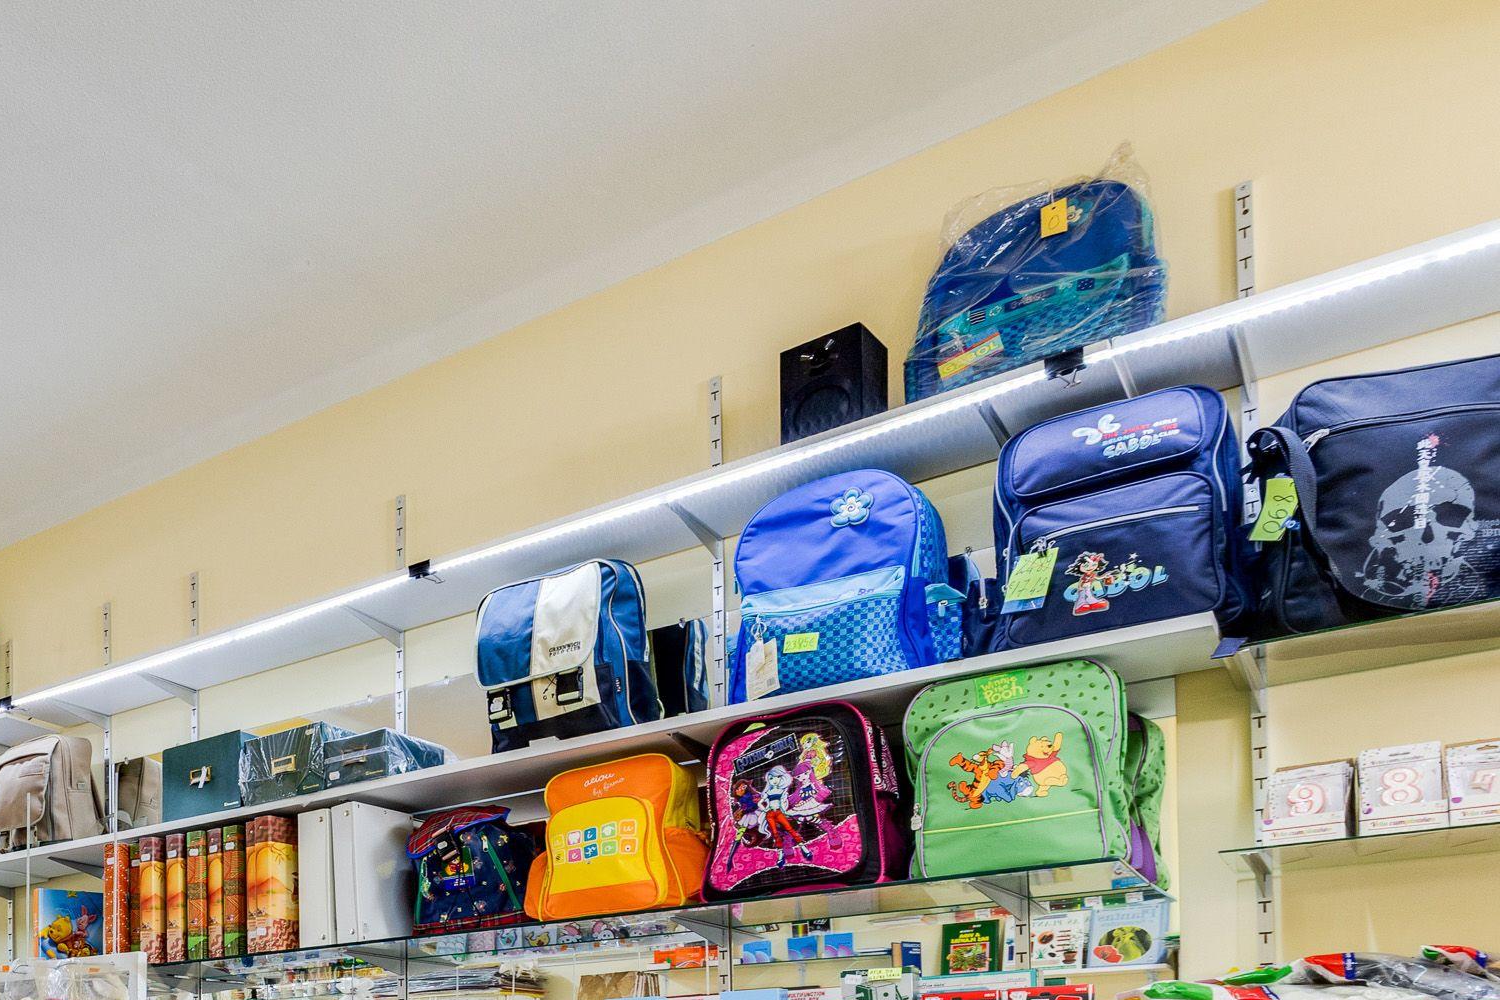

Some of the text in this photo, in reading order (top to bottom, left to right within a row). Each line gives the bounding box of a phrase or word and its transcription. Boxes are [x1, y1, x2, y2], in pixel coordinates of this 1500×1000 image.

[1102, 435, 1161, 459] CABOL
[548, 641, 581, 653] GREENWICH
[984, 682, 1024, 704] Pooh
[1382, 767, 1422, 806] 8
[786, 991, 825, 999] MULTIFUNCTION
